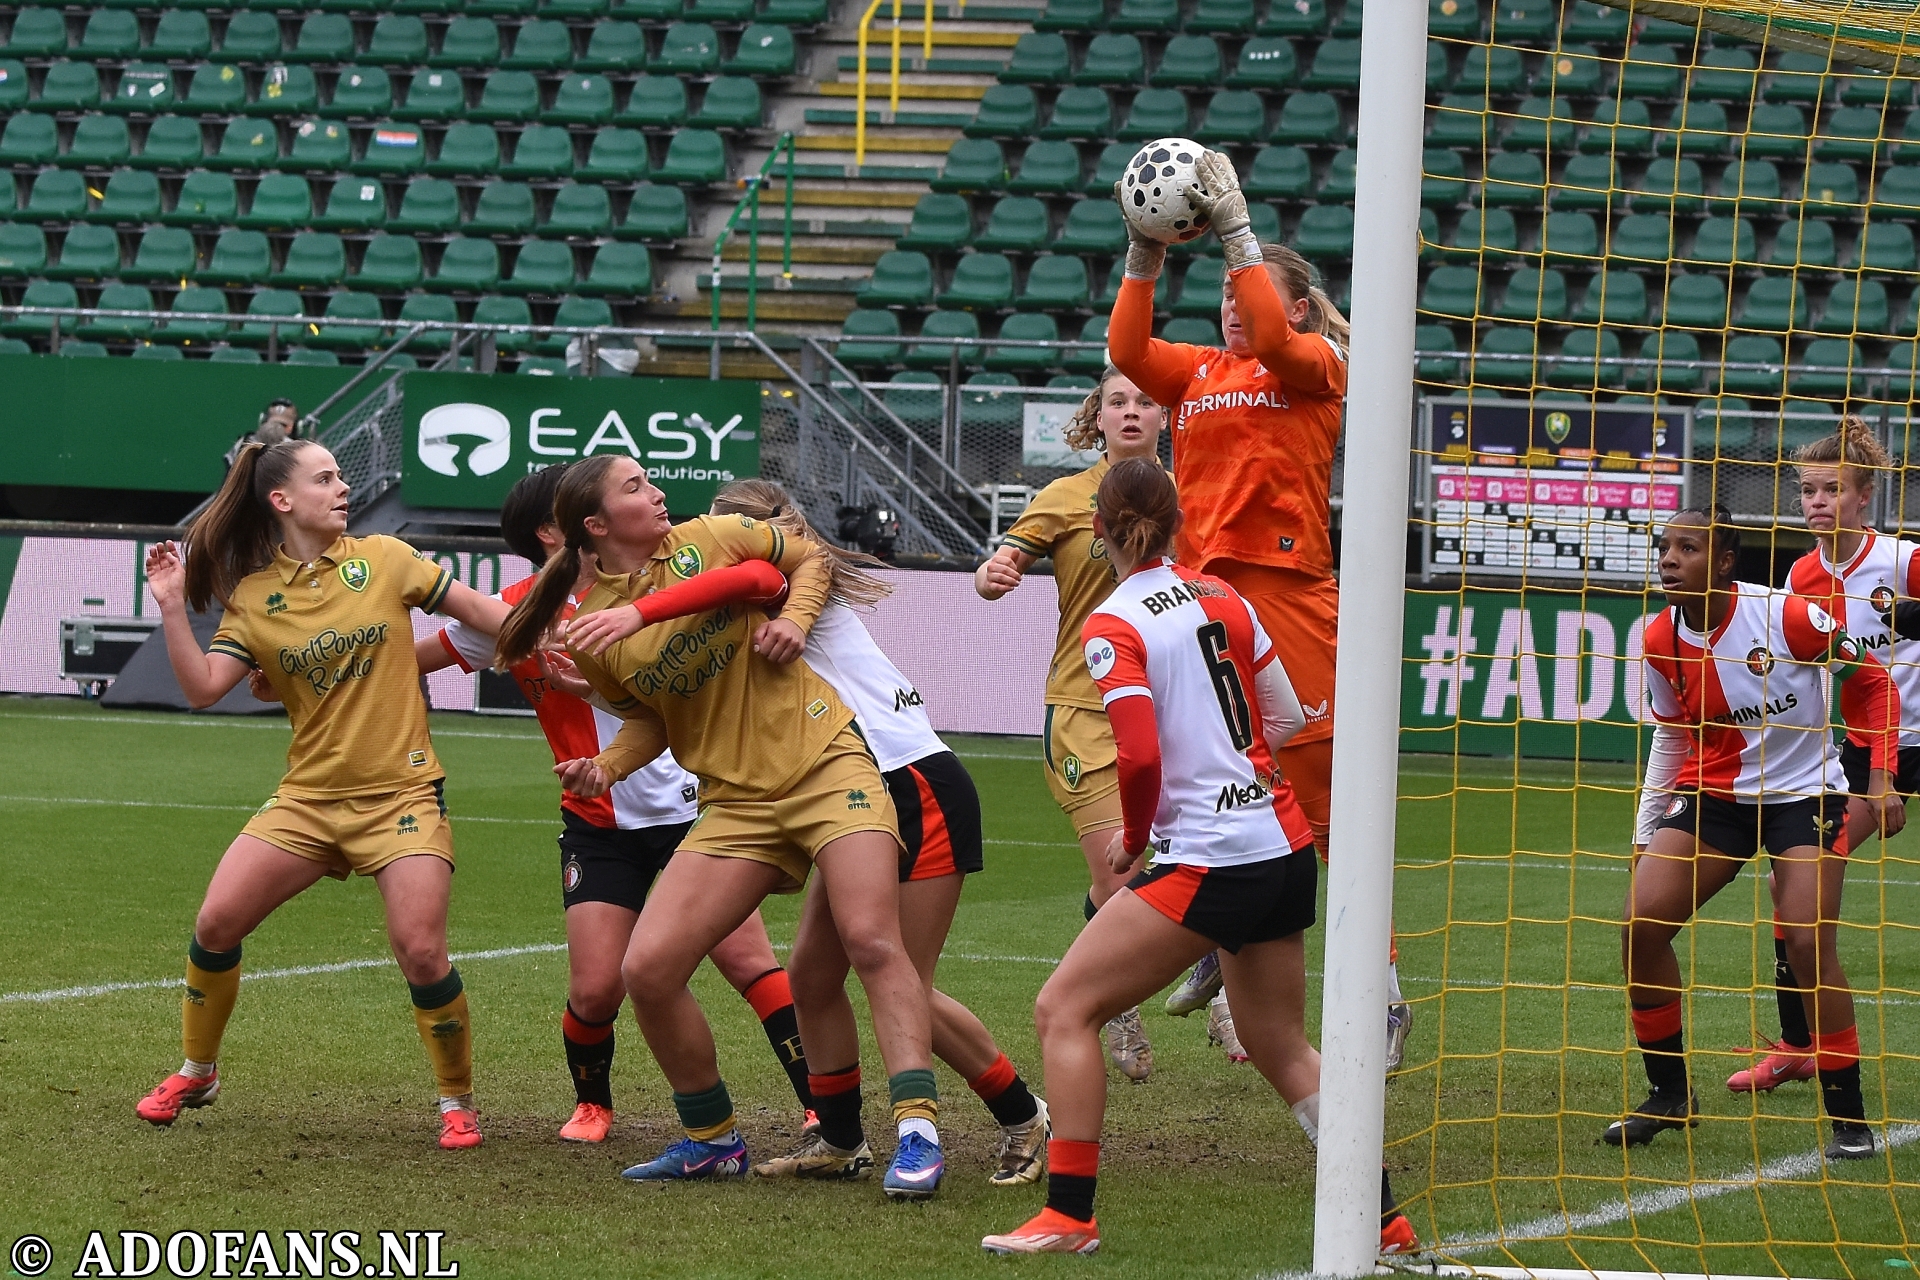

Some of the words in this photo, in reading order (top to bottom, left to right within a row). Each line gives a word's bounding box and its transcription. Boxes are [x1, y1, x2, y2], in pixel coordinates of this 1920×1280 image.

[529, 408, 743, 461] EASY
[646, 464, 735, 481] olutions
[279, 621, 389, 675] GirlPower
[633, 603, 735, 698] GirlPower
[667, 640, 736, 699] Radio
[306, 655, 374, 697] Radio
[1196, 620, 1256, 752] 6
[847, 802, 871, 810] errea
